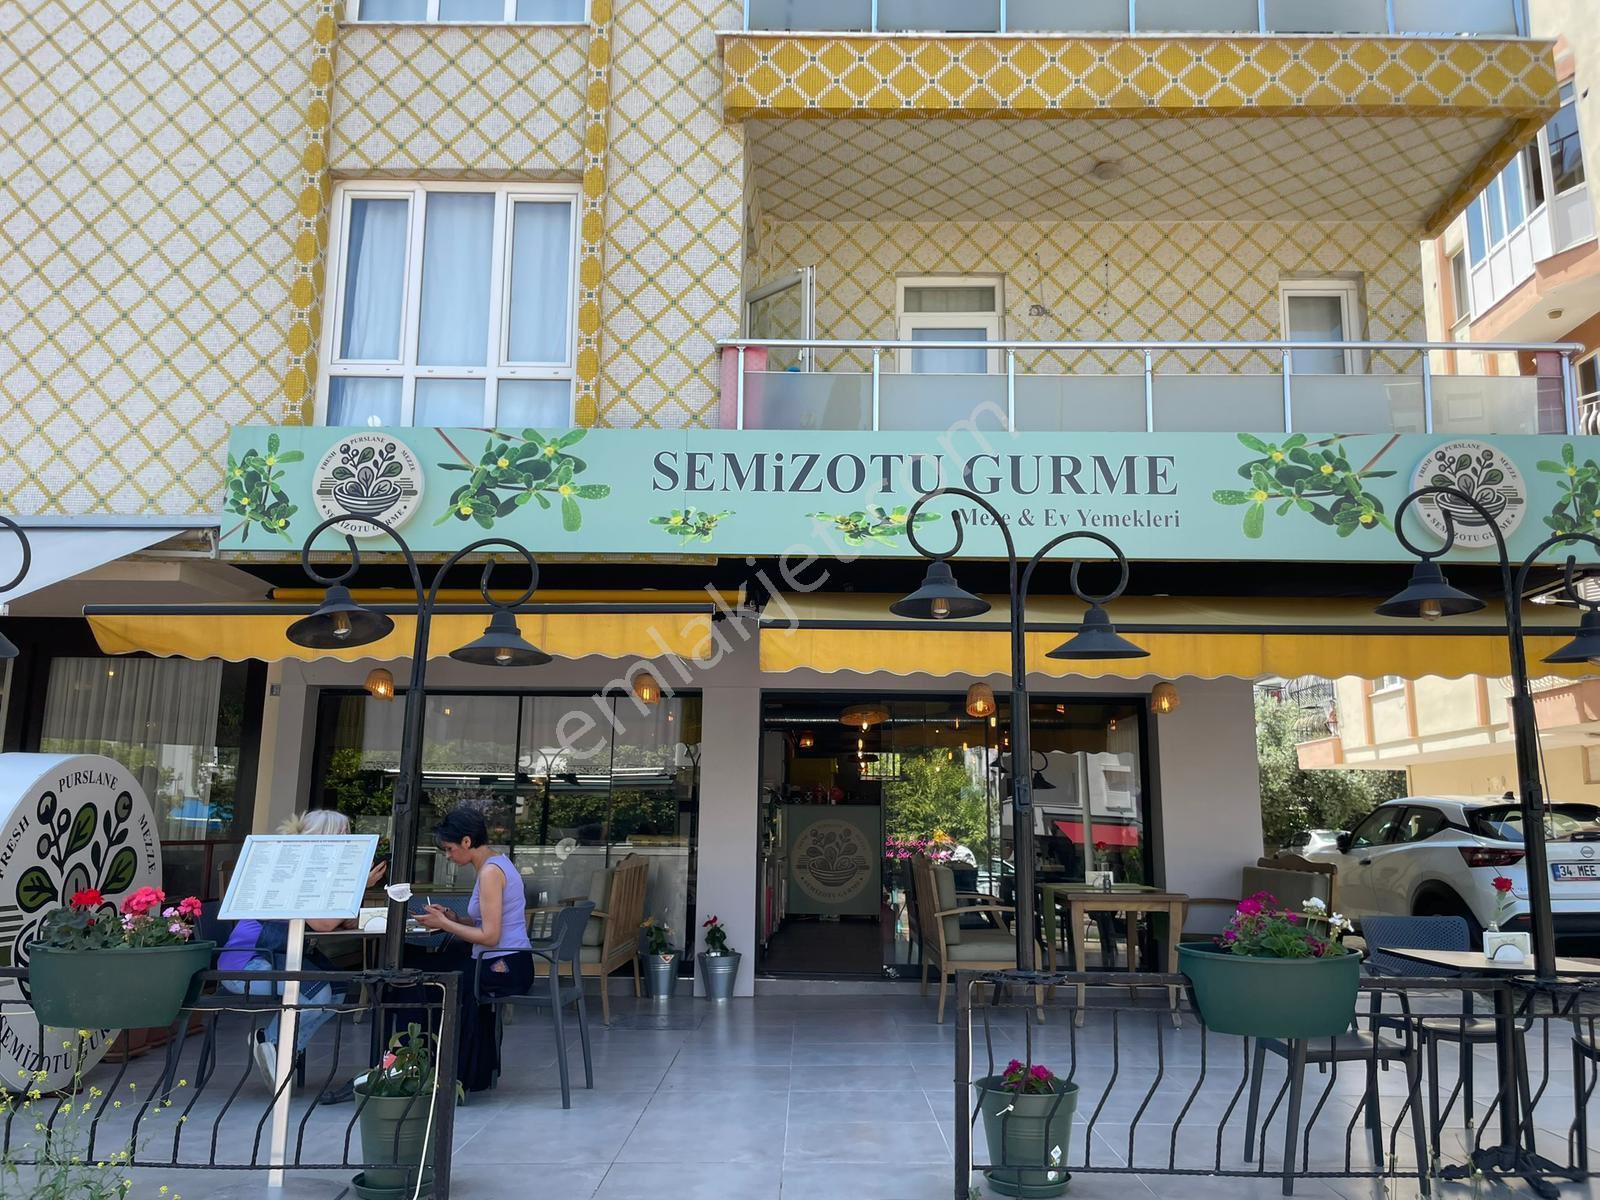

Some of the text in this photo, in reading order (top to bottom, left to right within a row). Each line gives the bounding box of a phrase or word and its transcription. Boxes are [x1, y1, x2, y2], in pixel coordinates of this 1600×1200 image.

[349, 436, 385, 445] PURSLANE
[1444, 443, 1481, 452] PURSLANE
[320, 450, 337, 471] FRESH
[401, 450, 416, 472] MEZZE
[1418, 458, 1432, 478] FRESH
[1499, 457, 1517, 480] MEZZE
[963, 453, 1179, 496] GURME
[372, 510, 405, 531] GRME
[1018, 508, 1035, 526] &
[1044, 508, 1070, 527] Ev
[1076, 508, 1181, 528] Yemekleri
[1482, 519, 1513, 540] GUME
[58, 769, 119, 793] PURSLANE
[137, 813, 157, 875] MEZZE
[1560, 865, 1597, 877] 34 MEE
